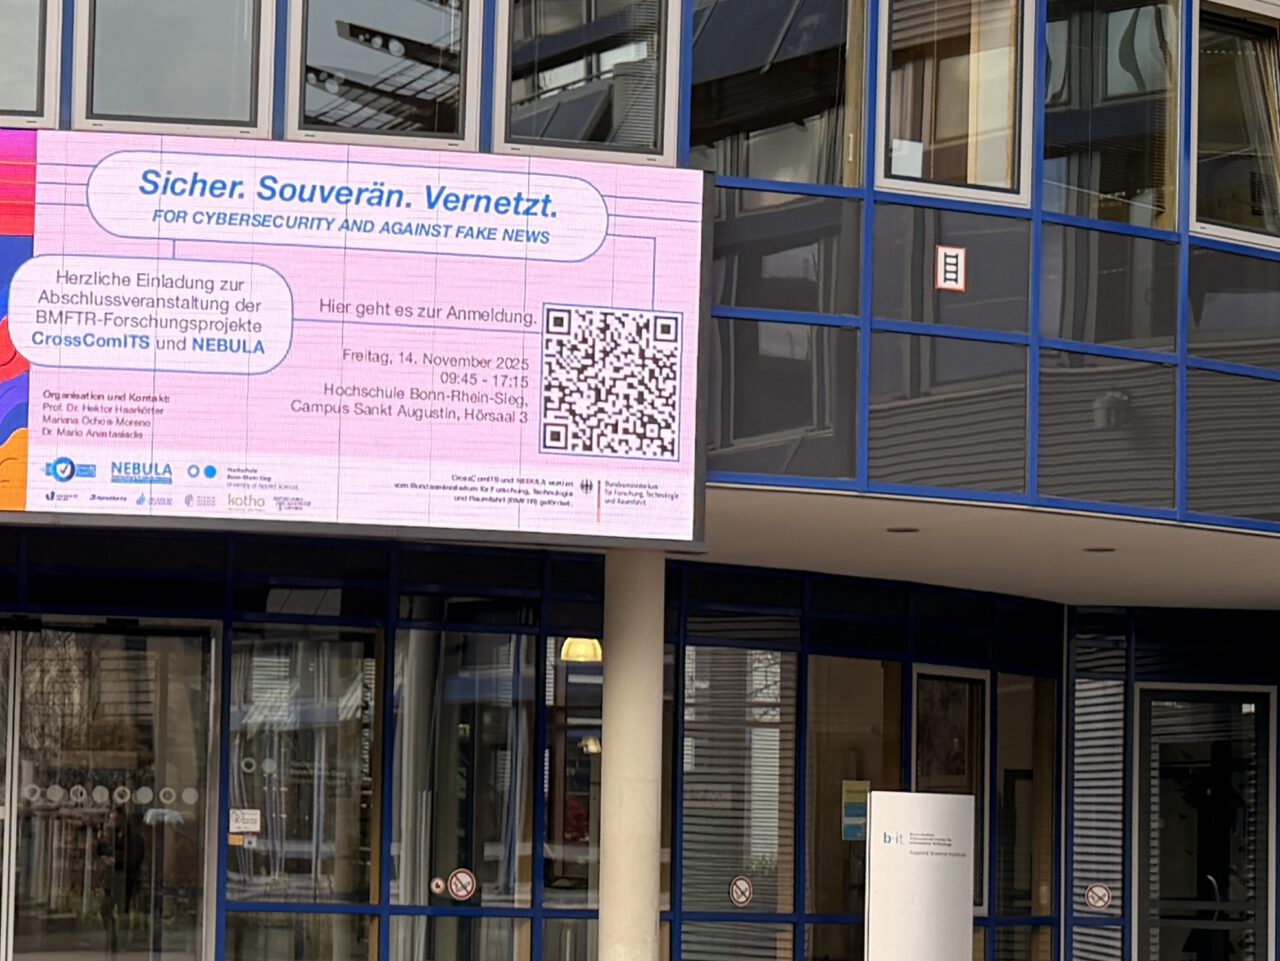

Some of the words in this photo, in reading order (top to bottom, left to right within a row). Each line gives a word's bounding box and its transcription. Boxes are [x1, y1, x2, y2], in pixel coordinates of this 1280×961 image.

[138, 168, 245, 199] Sicher.
[256, 175, 412, 208] Souverän.
[425, 184, 558, 218] Vernetzt.
[152, 209, 188, 223] FOR
[192, 211, 336, 231] CYBERSECURITY
[338, 218, 375, 233] AND
[379, 221, 453, 239] AGAINST
[454, 225, 498, 241] FAKE
[502, 228, 551, 245] NEWS
[56, 269, 131, 287] Herzliche
[136, 273, 214, 294] Einladung
[219, 279, 245, 292] zur
[38, 289, 229, 315] Abschlussveranstaltung
[235, 298, 262, 313] der
[319, 298, 351, 314] Hier
[355, 301, 390, 319] geht
[394, 305, 413, 317] es
[417, 306, 442, 319] zur
[446, 305, 537, 328] Anmeldung.
[35, 309, 262, 334] BMFTR-Forschungsprojekte
[31, 331, 150, 350] CrossComITS
[156, 336, 187, 351] und
[192, 337, 265, 355] NEBULA
[342, 348, 393, 366] Freitag,
[399, 351, 418, 365] 14.
[422, 352, 492, 369] November
[496, 356, 529, 371] 2025
[440, 371, 477, 386] 09:45
[493, 374, 529, 389] 17:15
[43, 389, 105, 401] Organisation
[107, 392, 126, 401] und
[324, 382, 405, 400] Hochschule
[410, 387, 528, 408] Bonn-Rhein-Sieg,
[42, 414, 79, 424] Mariana
[116, 416, 151, 427] Moreno
[82, 403, 113, 414] Hektor
[115, 405, 164, 415] Haarkötter
[290, 399, 350, 415] Campus
[354, 402, 392, 416] Sankt
[397, 404, 460, 421] Augustin,
[464, 408, 516, 422] Hörsaal
[519, 411, 528, 424] 3
[57, 427, 83, 437] Mario
[111, 462, 172, 476] NEBULA
